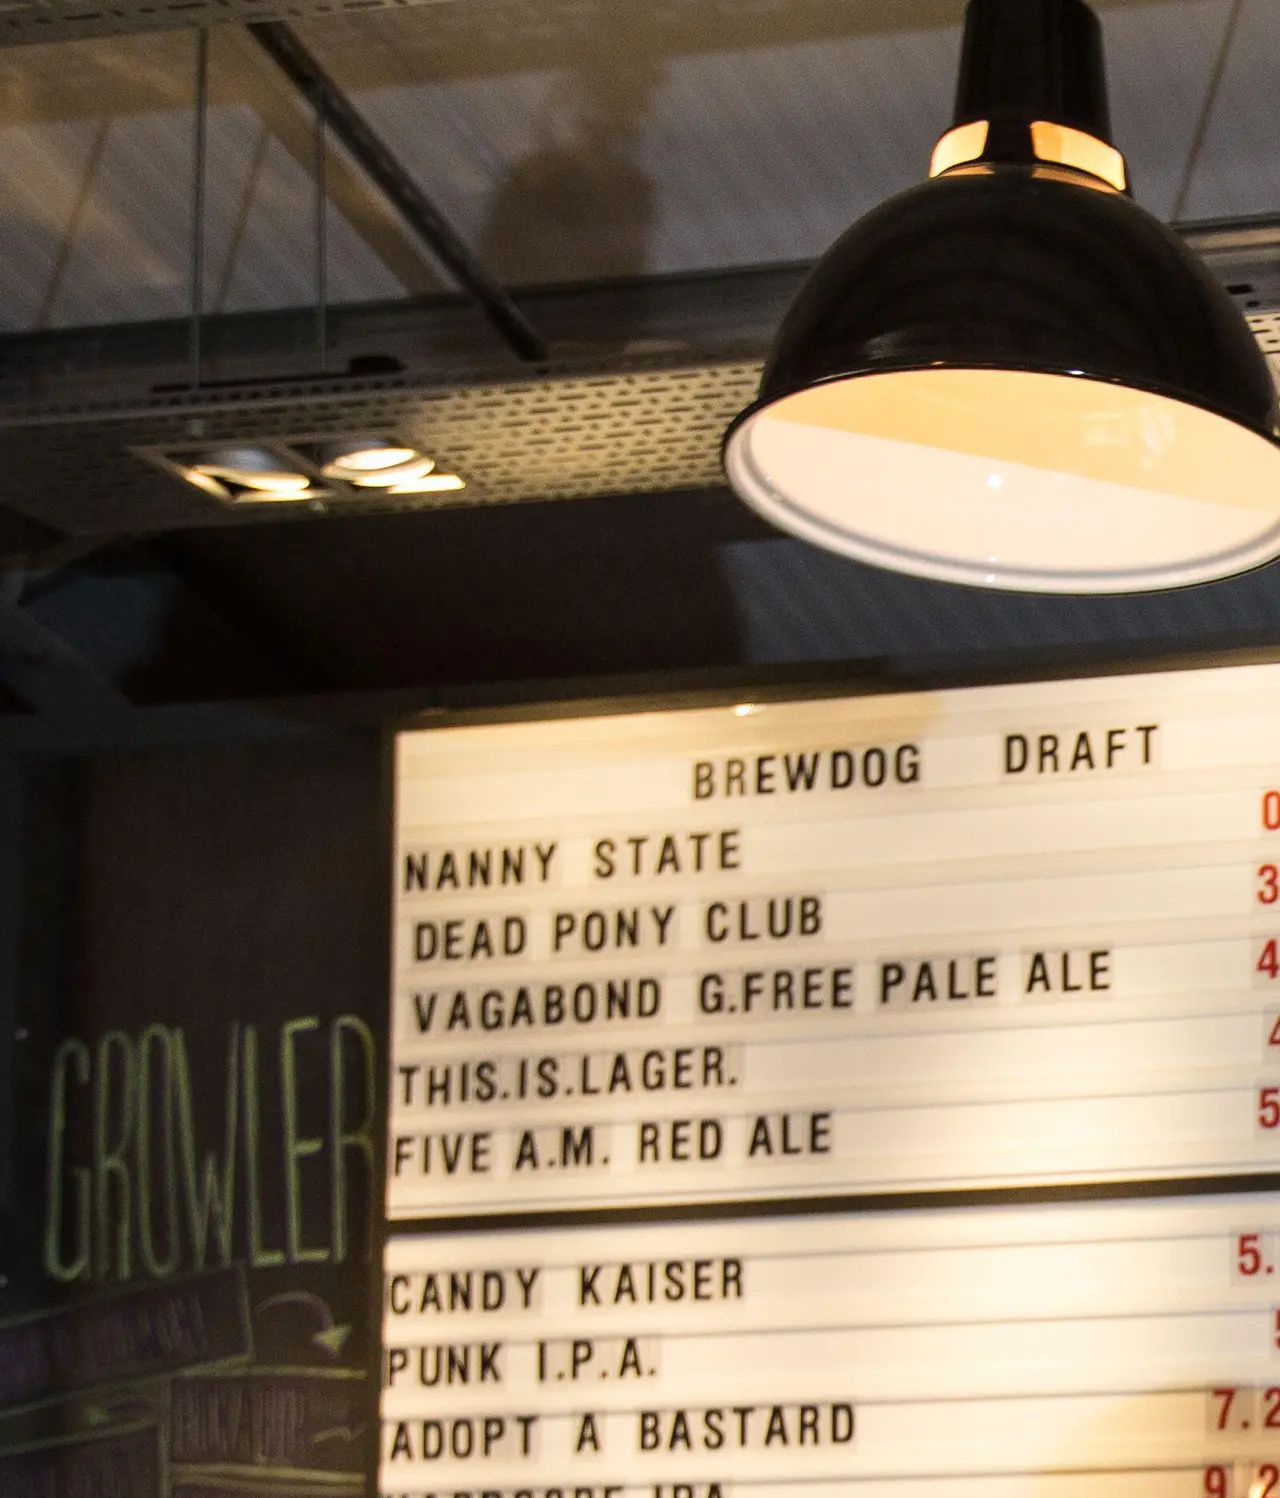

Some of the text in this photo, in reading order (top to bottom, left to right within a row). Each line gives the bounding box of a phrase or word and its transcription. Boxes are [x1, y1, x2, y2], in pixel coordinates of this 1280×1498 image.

[693, 725, 1160, 800] BREWDOG DRAFT
[403, 830, 743, 891] NANNY STATE
[414, 896, 823, 963] DEAD PONY CLUB
[413, 949, 1112, 1033] VAGABOND G.FREE PALE ALE
[399, 1046, 738, 1106] THIS.IS.LAGER.
[43, 1013, 377, 1283] GROWLER
[394, 1111, 833, 1178] FIVE A.M. RED ALE
[390, 1257, 744, 1316] CANDY KAISER
[387, 1337, 658, 1388] PUNK I.P.A.
[390, 1414, 539, 1461] ADOPT
[576, 1413, 600, 1454] A
[639, 1403, 856, 1451] BASTARD
